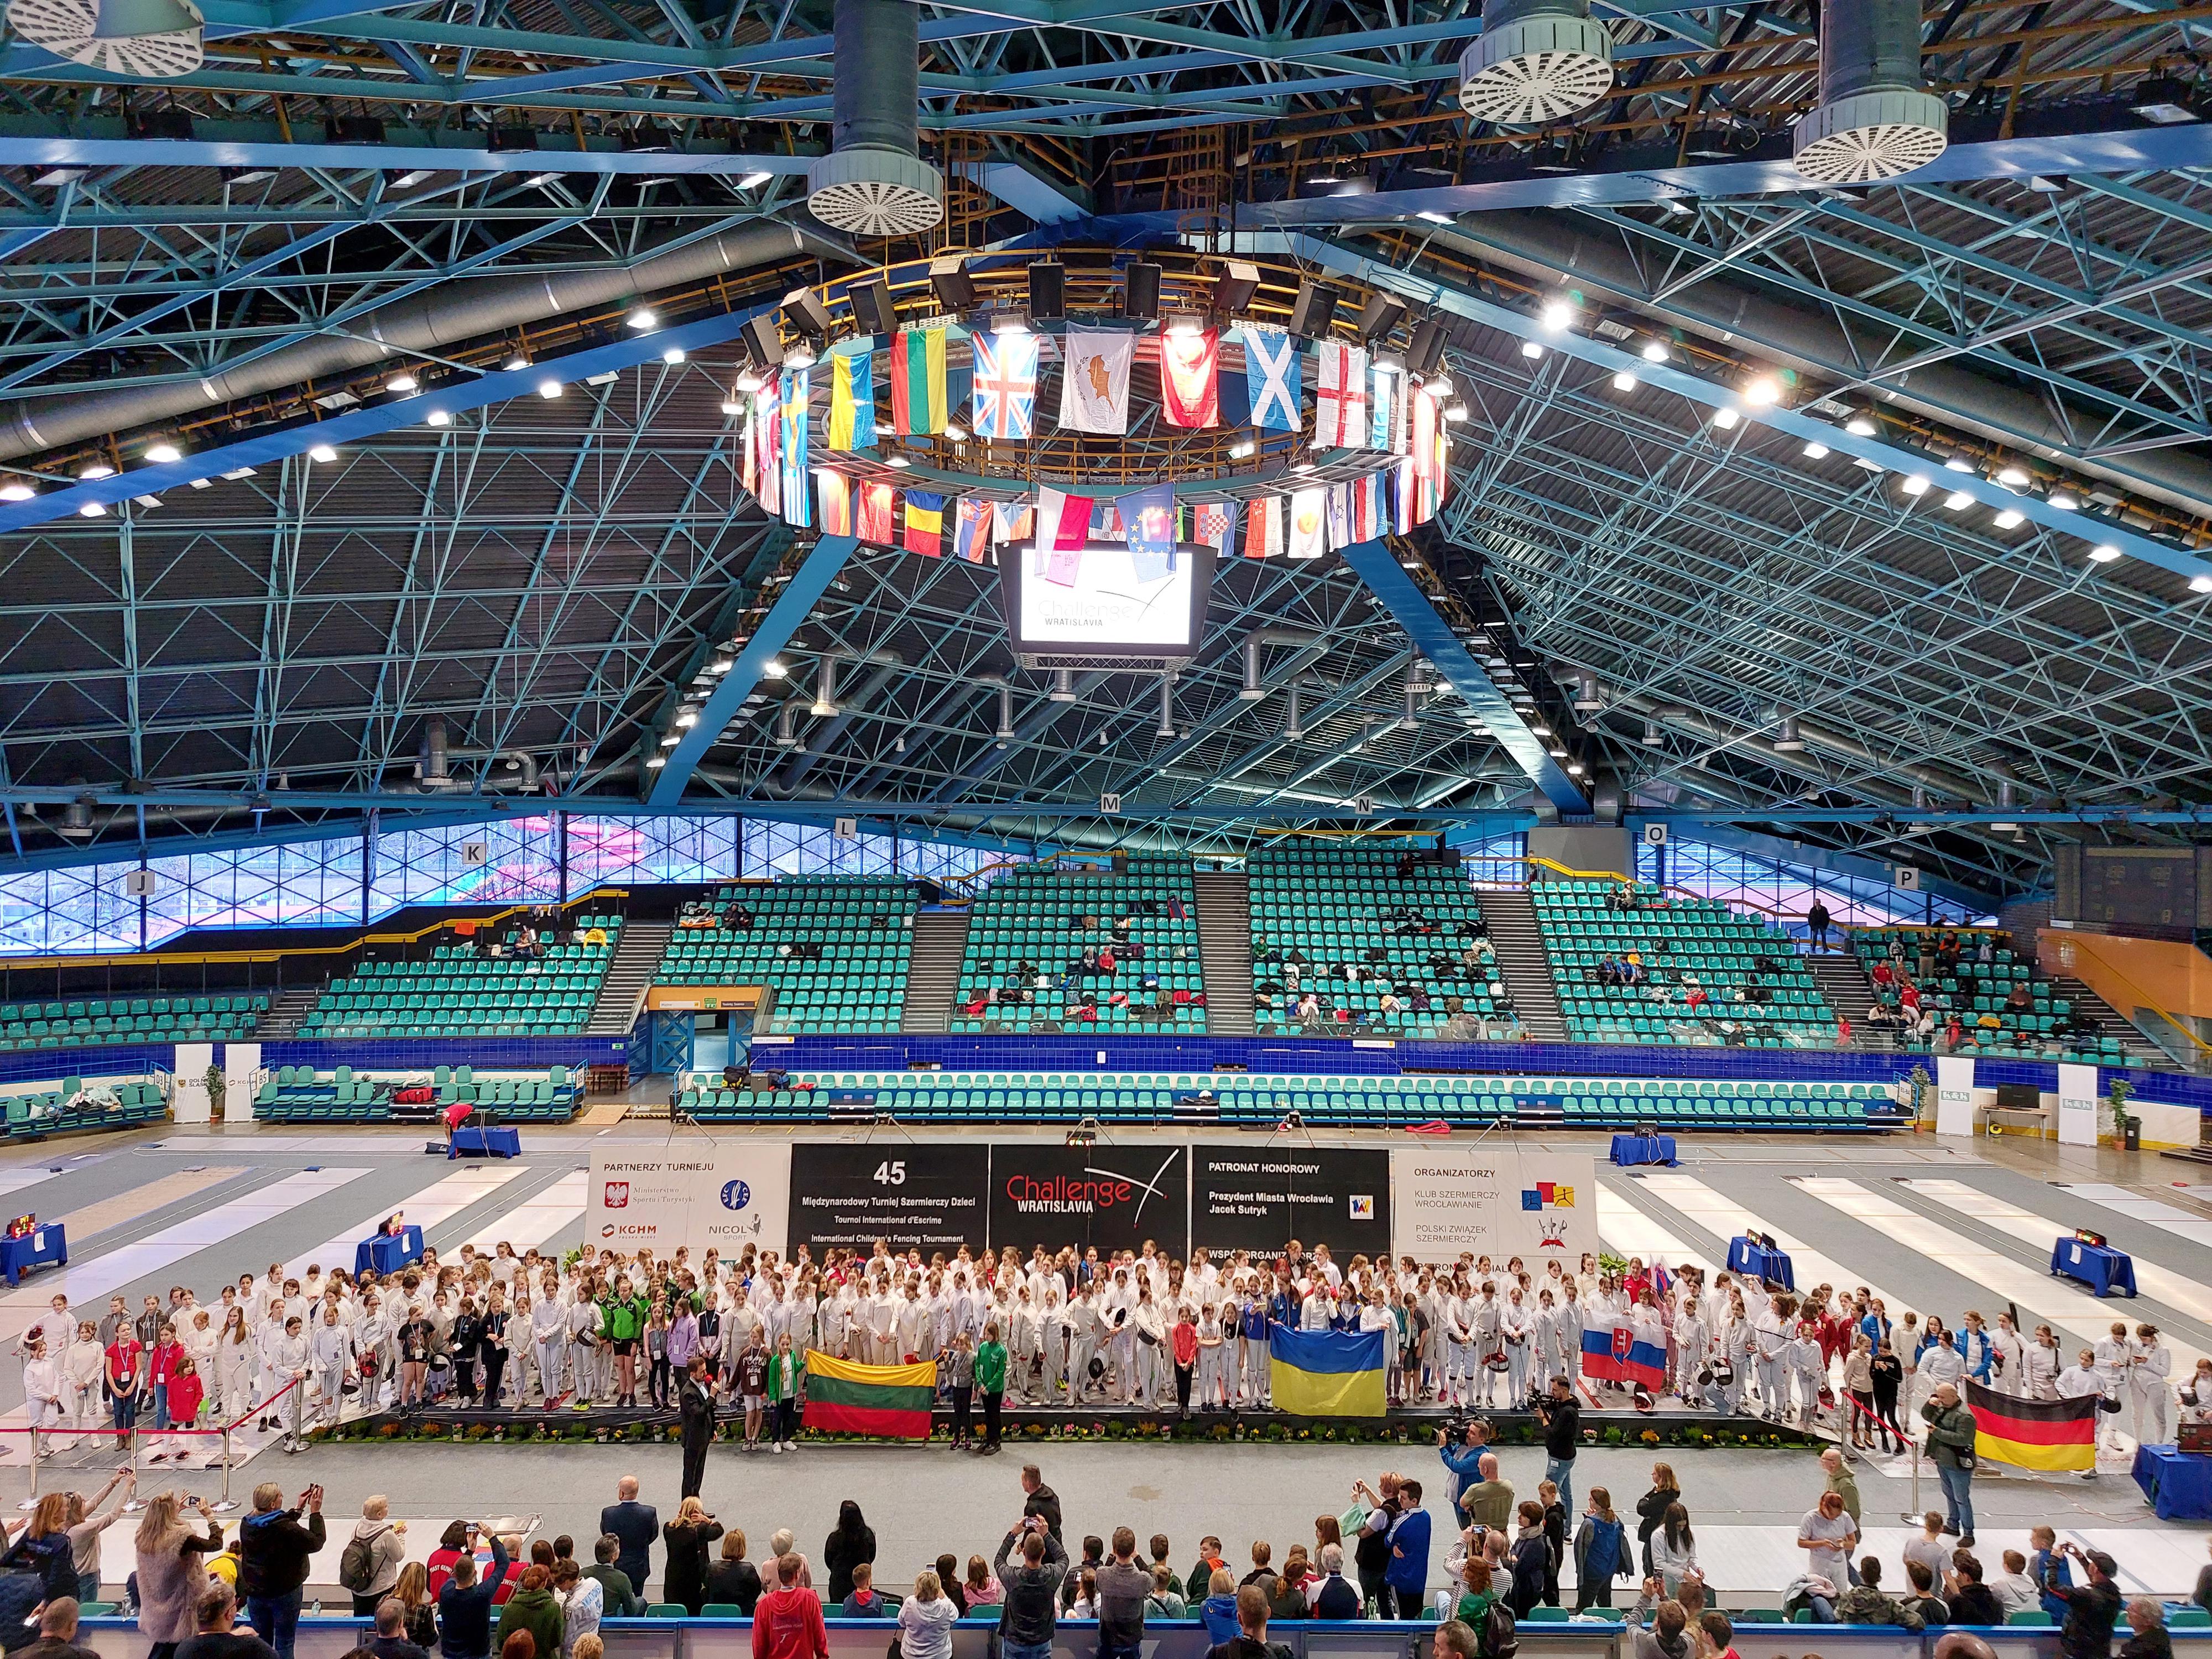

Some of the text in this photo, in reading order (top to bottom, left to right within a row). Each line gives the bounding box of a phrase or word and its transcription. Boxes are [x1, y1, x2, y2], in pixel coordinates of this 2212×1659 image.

[1045, 618, 1103, 627] WRATISLAVIA
[1103, 797, 1119, 810] M
[1359, 800, 1370, 812] N
[841, 821, 849, 836] L
[1648, 827, 1663, 842] O
[468, 846, 480, 861] K
[137, 875, 145, 891] J
[1902, 871, 1913, 885] P
[156, 1074, 163, 1086] D3
[259, 1073, 267, 1084] B5
[604, 1162, 714, 1172] PARTNERZY TURNIEJU
[873, 1161, 906, 1185] 45
[1208, 1162, 1321, 1175] PATRONAT HONOROWY
[1414, 1168, 1496, 1178] ORGANIZATORZY
[1006, 1175, 1132, 1208] Challenge
[1209, 1191, 1334, 1204] Prezydent Miasta Wrocławia
[1415, 1190, 1500, 1200] KLUB SZERMIERCZY
[633, 1196, 656, 1204] Sportu
[661, 1196, 696, 1204] Turystyki
[802, 1197, 976, 1209] Międzynarodowy Turniej Szermierczy Dzieci
[1018, 1199, 1094, 1213] WRATISLAVIA
[1415, 1200, 1483, 1209] WROCŁAWIANIE
[1209, 1204, 1267, 1217] Jacek Sutryk
[834, 1215, 942, 1225] Tournoi International d'Escrime
[619, 1225, 657, 1235] KGHM
[708, 1225, 747, 1235] NICOL
[1416, 1224, 1487, 1235] POLSKI ZWIĄZEK
[811, 1234, 964, 1244] International Children's Fencing Tournament
[1416, 1235, 1478, 1244] SZERMIERCZY
